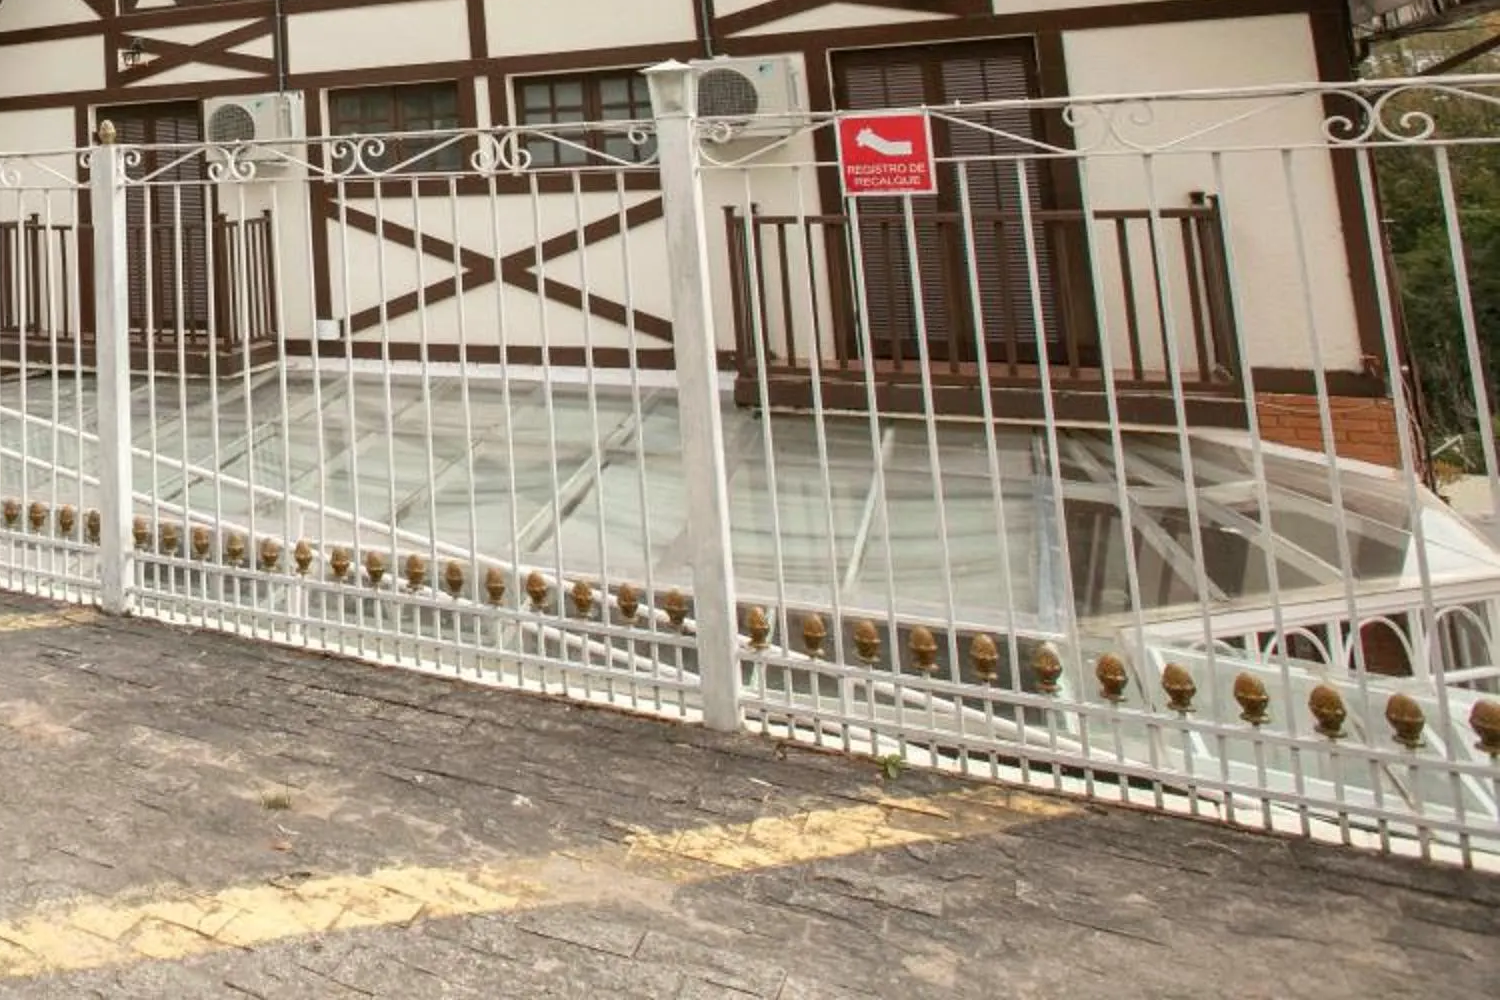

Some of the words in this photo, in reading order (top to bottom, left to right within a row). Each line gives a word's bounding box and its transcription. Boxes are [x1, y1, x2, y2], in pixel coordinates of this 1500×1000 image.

[847, 163, 907, 175] REGISTRO
[909, 162, 926, 173] DE
[854, 175, 921, 187] RECALQUE
